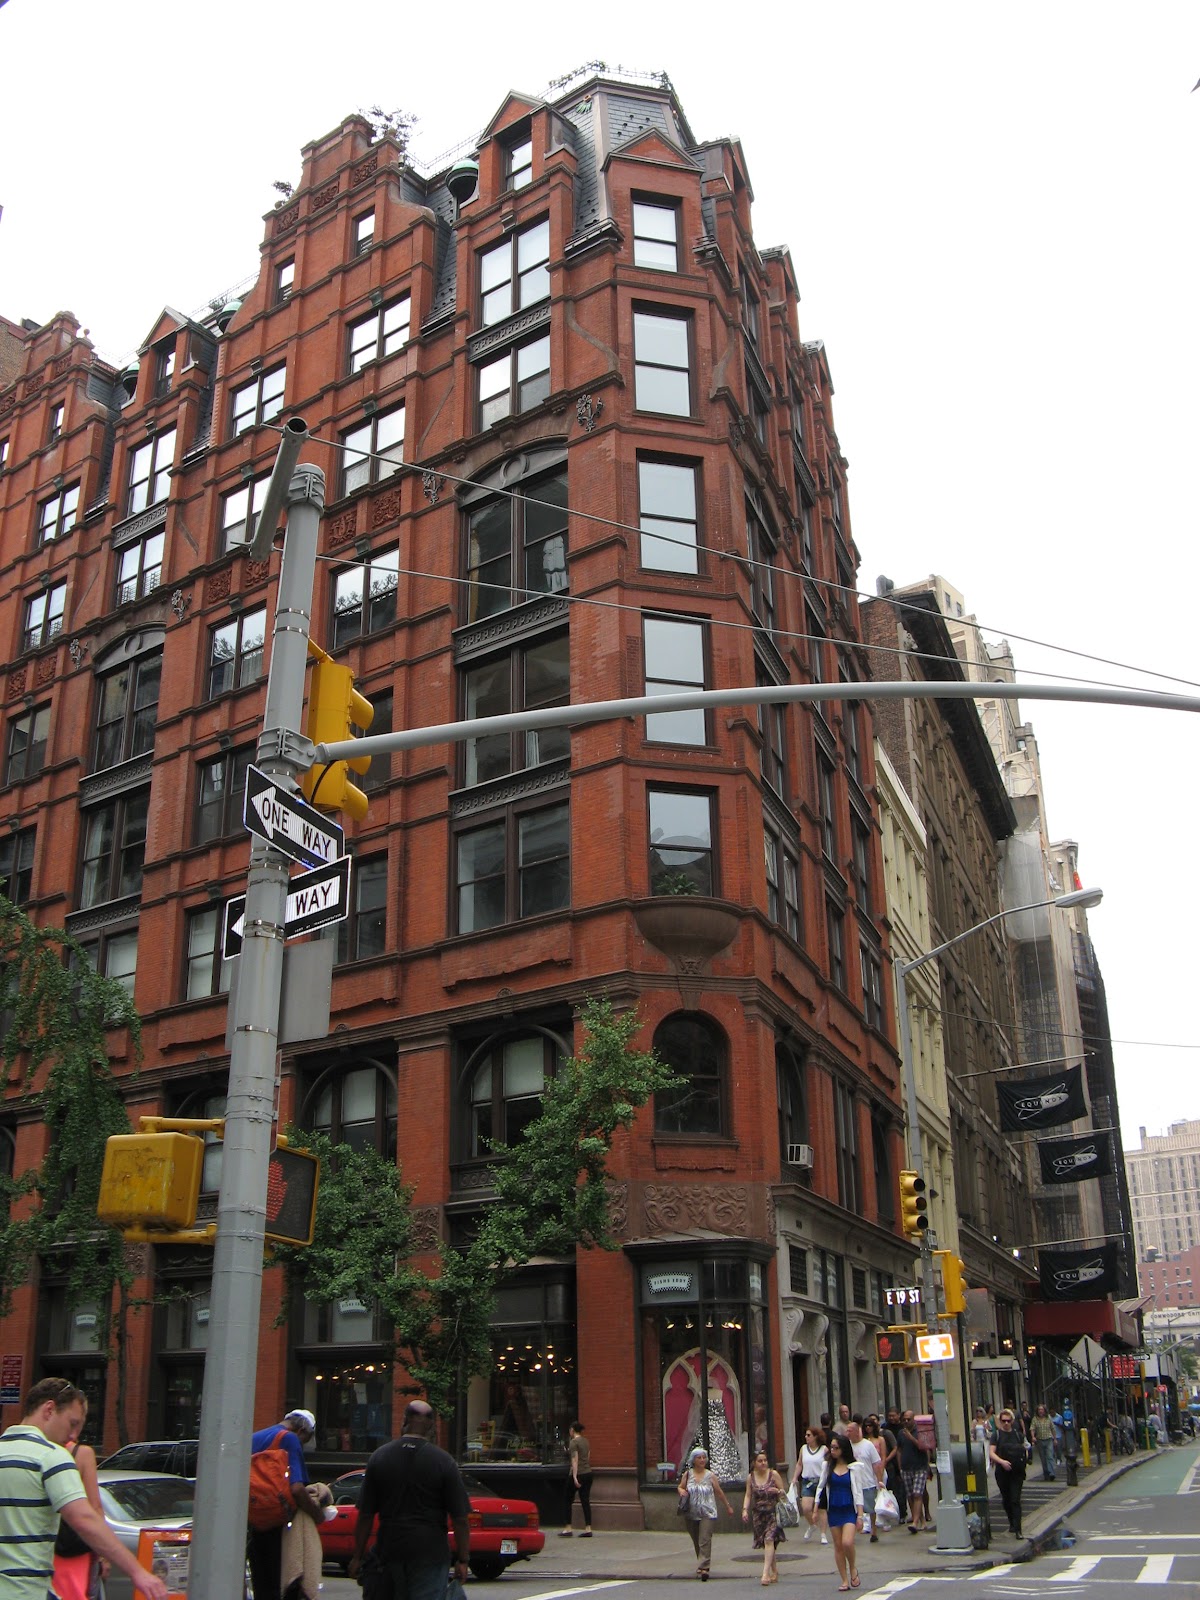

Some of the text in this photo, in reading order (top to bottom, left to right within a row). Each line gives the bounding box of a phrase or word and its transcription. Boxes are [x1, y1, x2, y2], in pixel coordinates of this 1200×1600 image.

[261, 797, 332, 858] ONE WAY
[295, 882, 333, 917] WAY
[1020, 1095, 1064, 1108] EQUINOX
[1058, 1154, 1093, 1165] EQUINOX
[1059, 1269, 1100, 1280] EQUINOX
[886, 1291, 893, 1305] E
[896, 1290, 906, 1304] 19
[908, 1289, 920, 1304] ST
